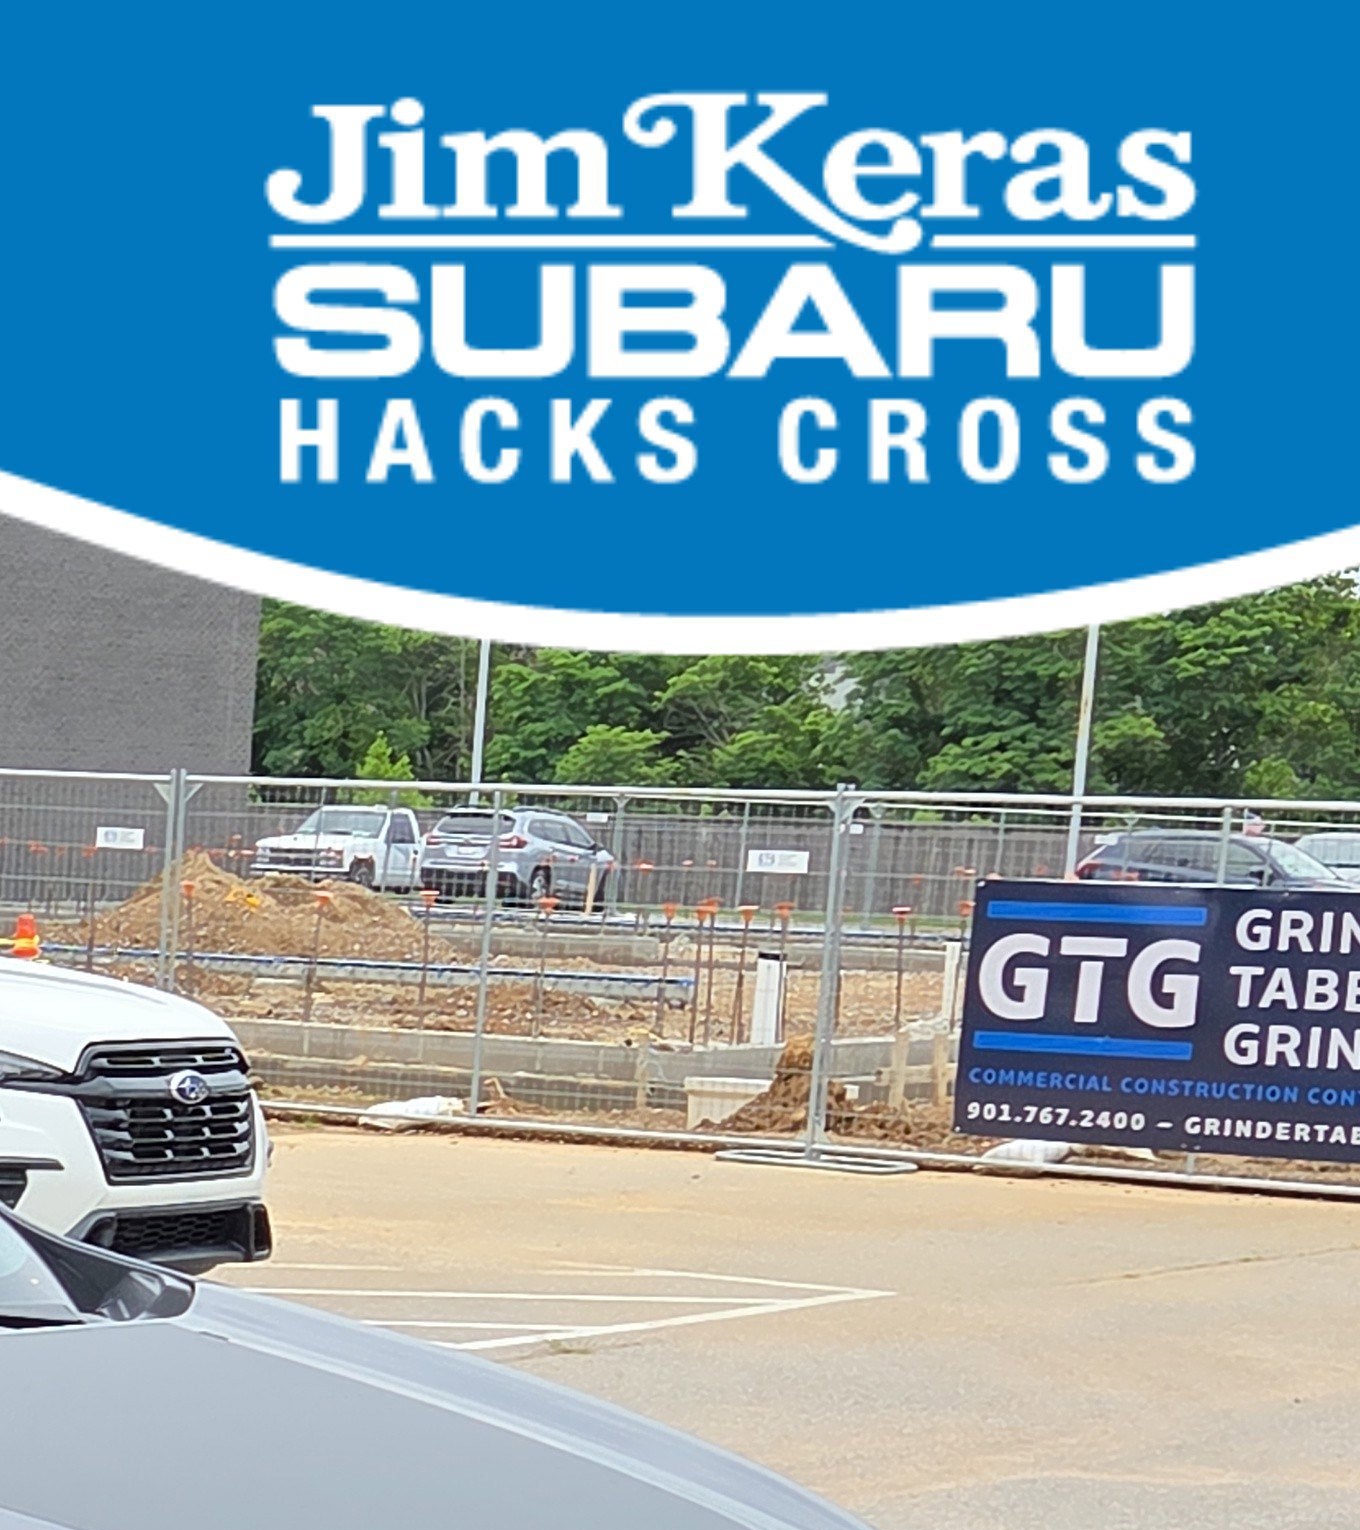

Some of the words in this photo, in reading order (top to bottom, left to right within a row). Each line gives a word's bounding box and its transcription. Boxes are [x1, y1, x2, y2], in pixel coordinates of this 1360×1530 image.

[978, 932, 1202, 1029] GTG
[1223, 1023, 1360, 1070] GRIN
[968, 1067, 1112, 1092] COMMERCIAL
[1120, 1076, 1299, 1103] CONSTRUCTION
[1307, 1086, 1360, 1107] CON
[966, 1101, 1147, 1131] 901.767.2400
